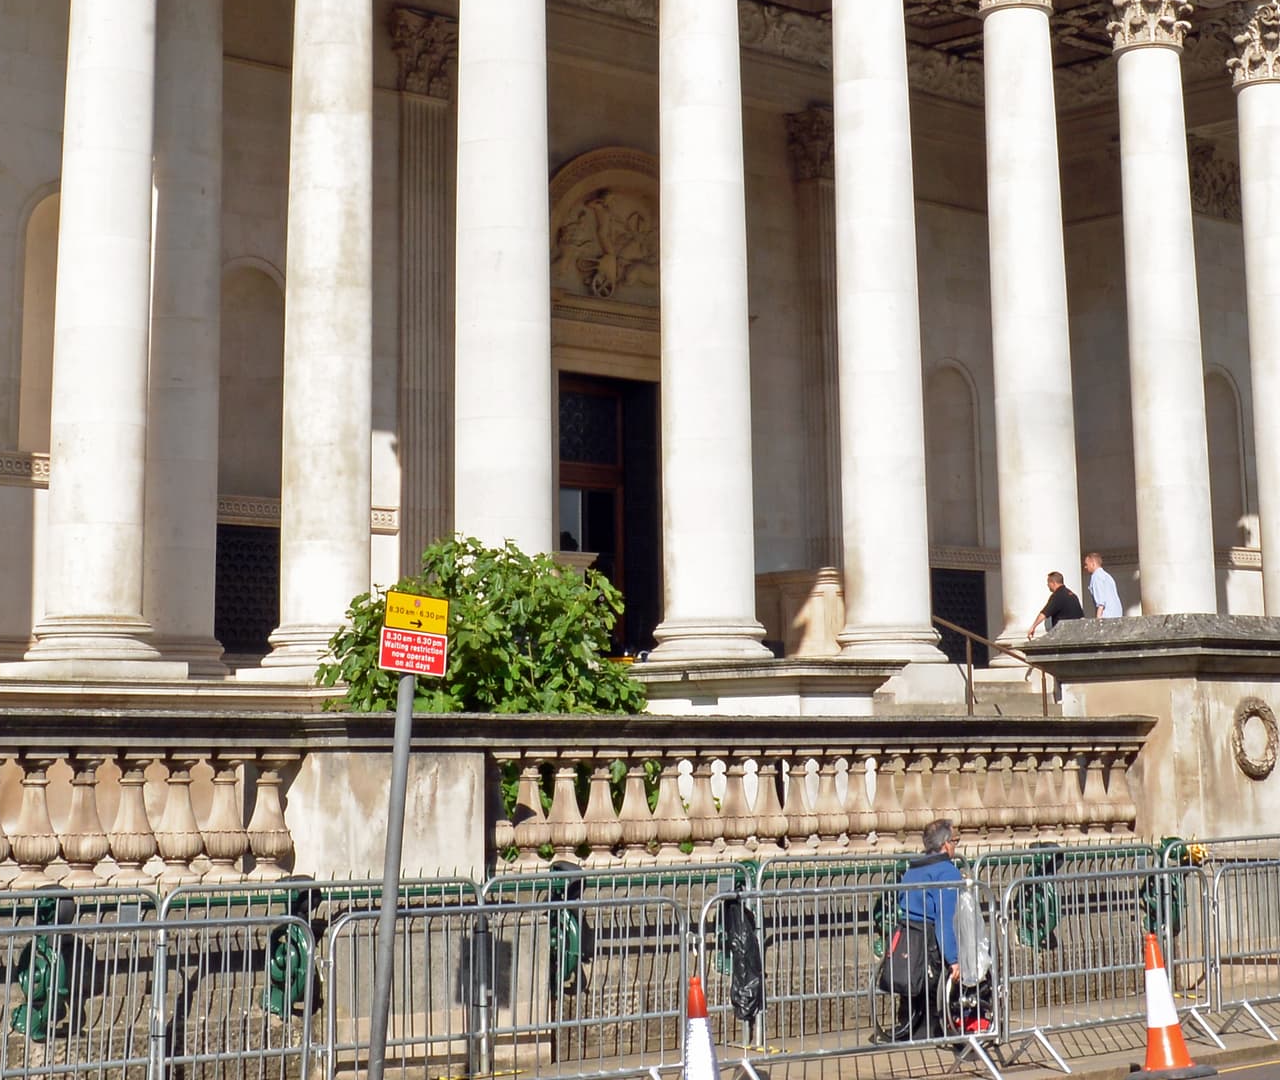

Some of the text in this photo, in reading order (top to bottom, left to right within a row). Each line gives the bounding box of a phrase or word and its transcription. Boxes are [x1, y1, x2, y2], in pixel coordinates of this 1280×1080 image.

[386, 632, 402, 641] 8.30
[416, 636, 432, 645] 6.30
[384, 640, 443, 655] Waiting restriction
[391, 650, 435, 663] now operates
[405, 660, 414, 668] all
[415, 662, 430, 671] days
